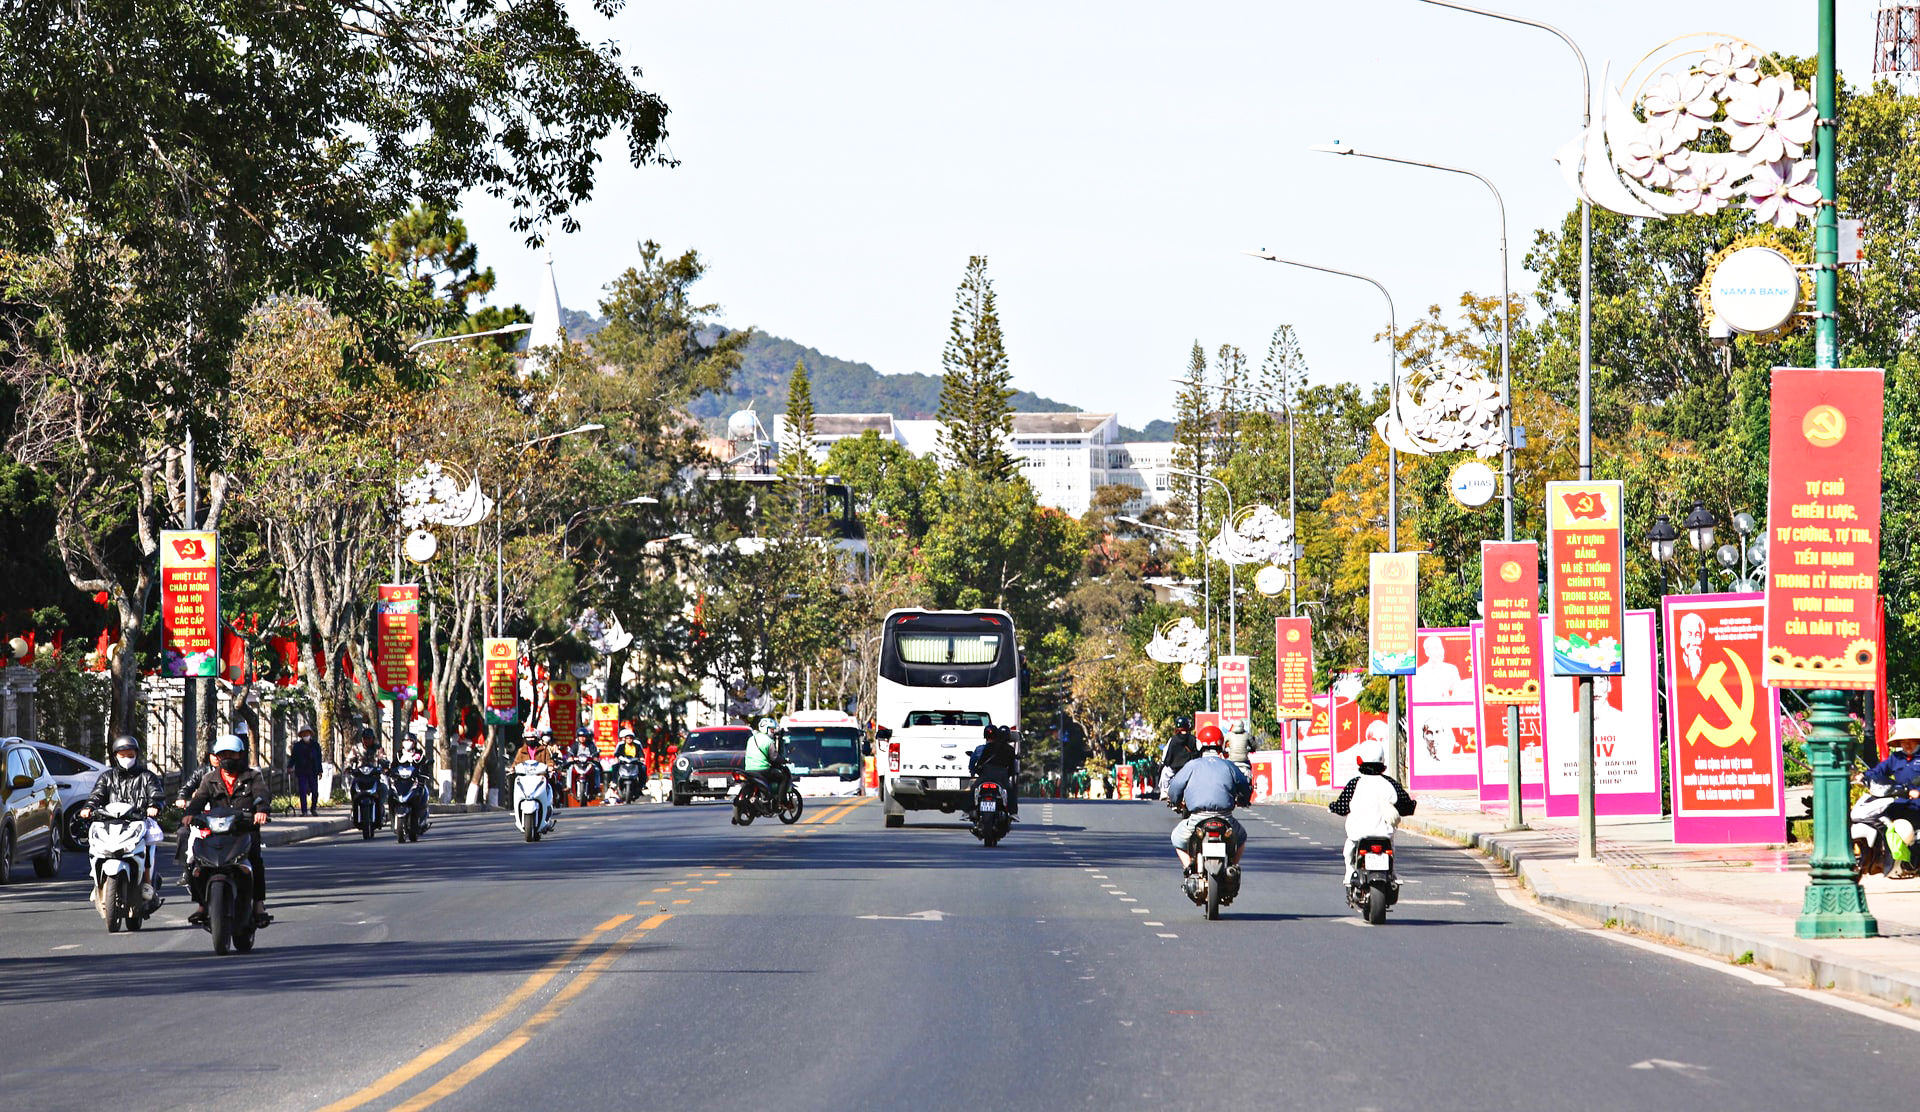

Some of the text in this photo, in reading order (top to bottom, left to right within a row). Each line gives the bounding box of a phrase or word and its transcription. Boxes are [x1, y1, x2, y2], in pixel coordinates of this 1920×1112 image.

[1806, 478, 1845, 498] TỰ CHỦ
[1792, 500, 1858, 522] CHIẾN LƯỢC,
[1566, 534, 1604, 546] XÂY DỰNG
[1776, 525, 1872, 545] TỰ CƯỜNG, TỰ TIN,
[1575, 546, 1596, 558] ĐẢNG
[1794, 547, 1854, 568] TIẾN MẠNH
[1561, 560, 1610, 574] VÀ HỆ THỐNG
[172, 571, 206, 582] NHIỆT LIỆT
[1568, 576, 1606, 588] CHÍNH TRỊ
[1774, 570, 1873, 589] TRONG KỶ NGUYÊN
[170, 582, 210, 592] CHÀO MỪNG
[177, 593, 202, 604] ĐẠI HỘI
[1561, 591, 1612, 602] TRONG SẠCH,
[1494, 598, 1528, 608] NHIỆT LIỆT
[1792, 596, 1854, 612] VƯƠN MÌNH
[174, 604, 204, 615] ĐẢNG BỘ
[1491, 610, 1531, 619] CHÀO MỪNG
[1564, 604, 1610, 616] VỮNG MẠNH
[175, 614, 204, 624] CÁC CẤP
[1566, 618, 1608, 630] TOÀN DIỆN!
[173, 626, 206, 637] NHIỆM KỲ
[1498, 622, 1524, 632] ĐẠI HỘI
[1786, 616, 1808, 634] CỦA
[1810, 619, 1832, 635] DÂN
[1835, 619, 1860, 638] TỘC!
[192, 638, 210, 646] 2030!
[1496, 632, 1526, 644] ĐẠI BIỂU
[1492, 644, 1530, 655] TOÀN QUỐC
[1492, 656, 1532, 666] LẦN THỨ XIV
[1494, 668, 1530, 678] CỦA ĐẢNG!
[1596, 744, 1614, 757] IV
